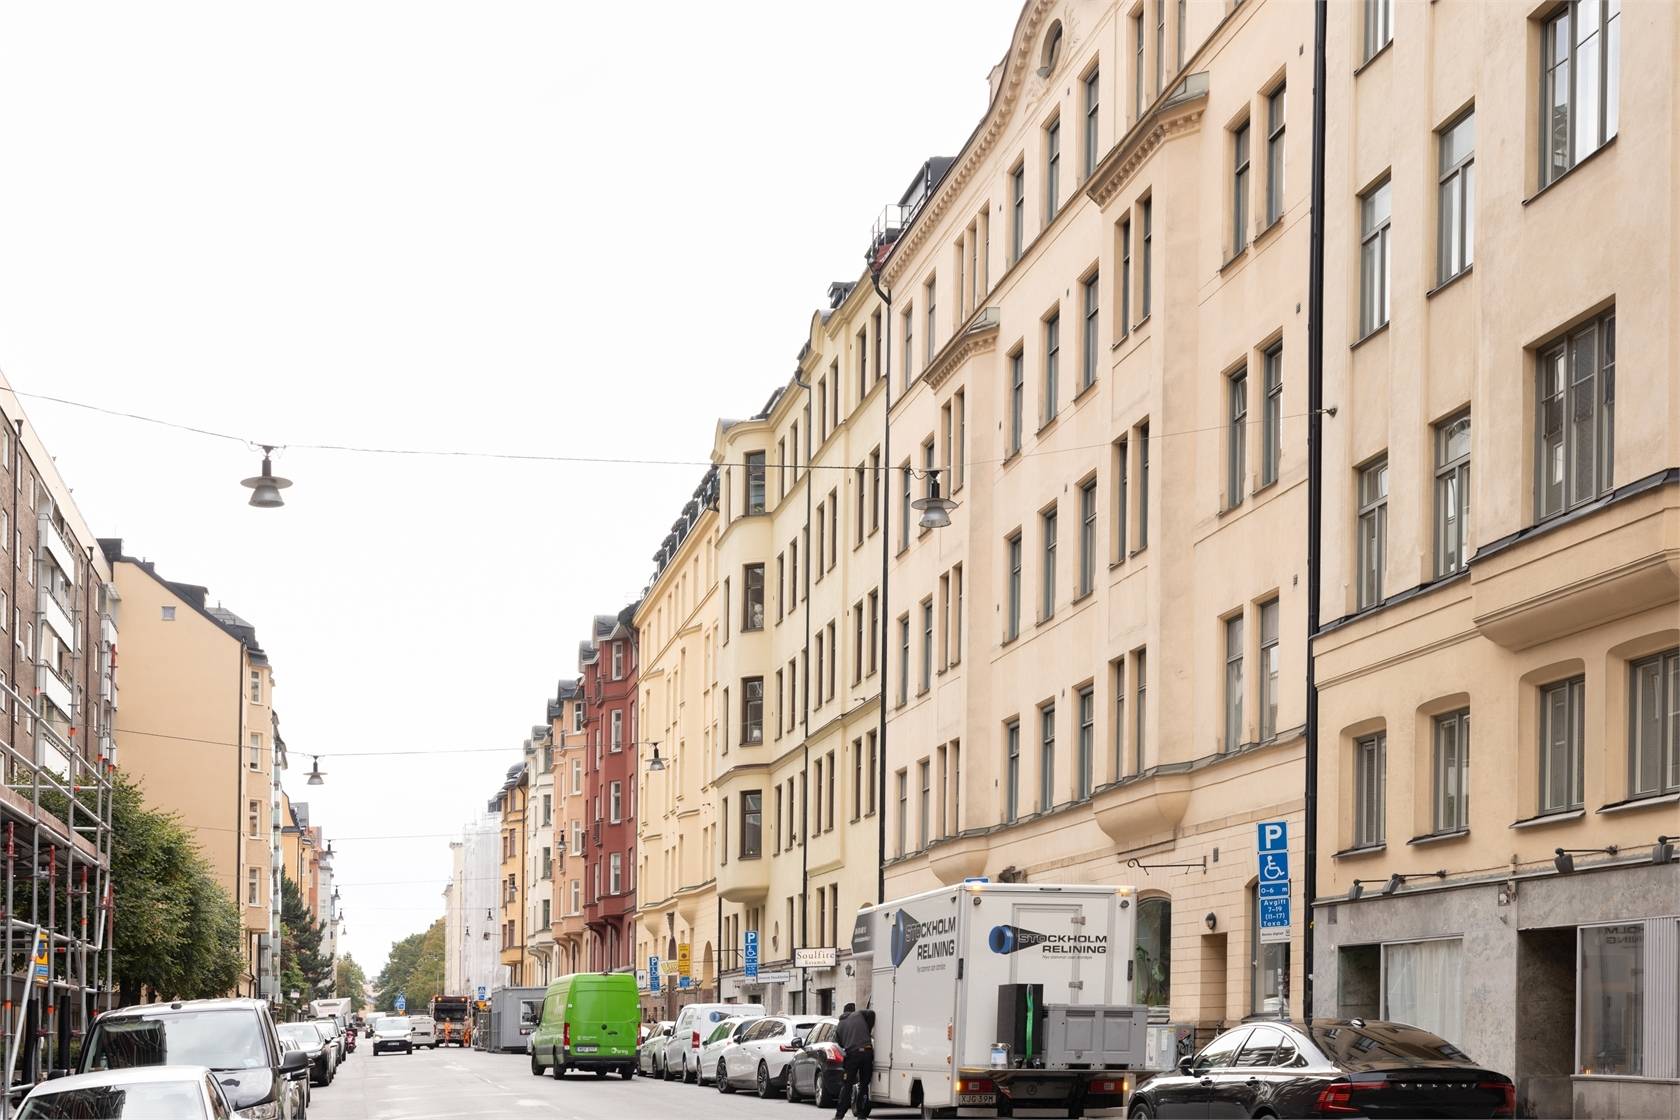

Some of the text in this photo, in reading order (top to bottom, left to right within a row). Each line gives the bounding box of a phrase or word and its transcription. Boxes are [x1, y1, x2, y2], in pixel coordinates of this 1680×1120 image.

[1265, 825, 1282, 849] P
[1263, 899, 1286, 907] Avgift
[905, 916, 956, 943] STOCKHOLM
[747, 932, 756, 943] P
[1018, 934, 1107, 943] STOCKHOLM
[917, 939, 955, 961] RELINING
[1042, 945, 1107, 954] RELINING
